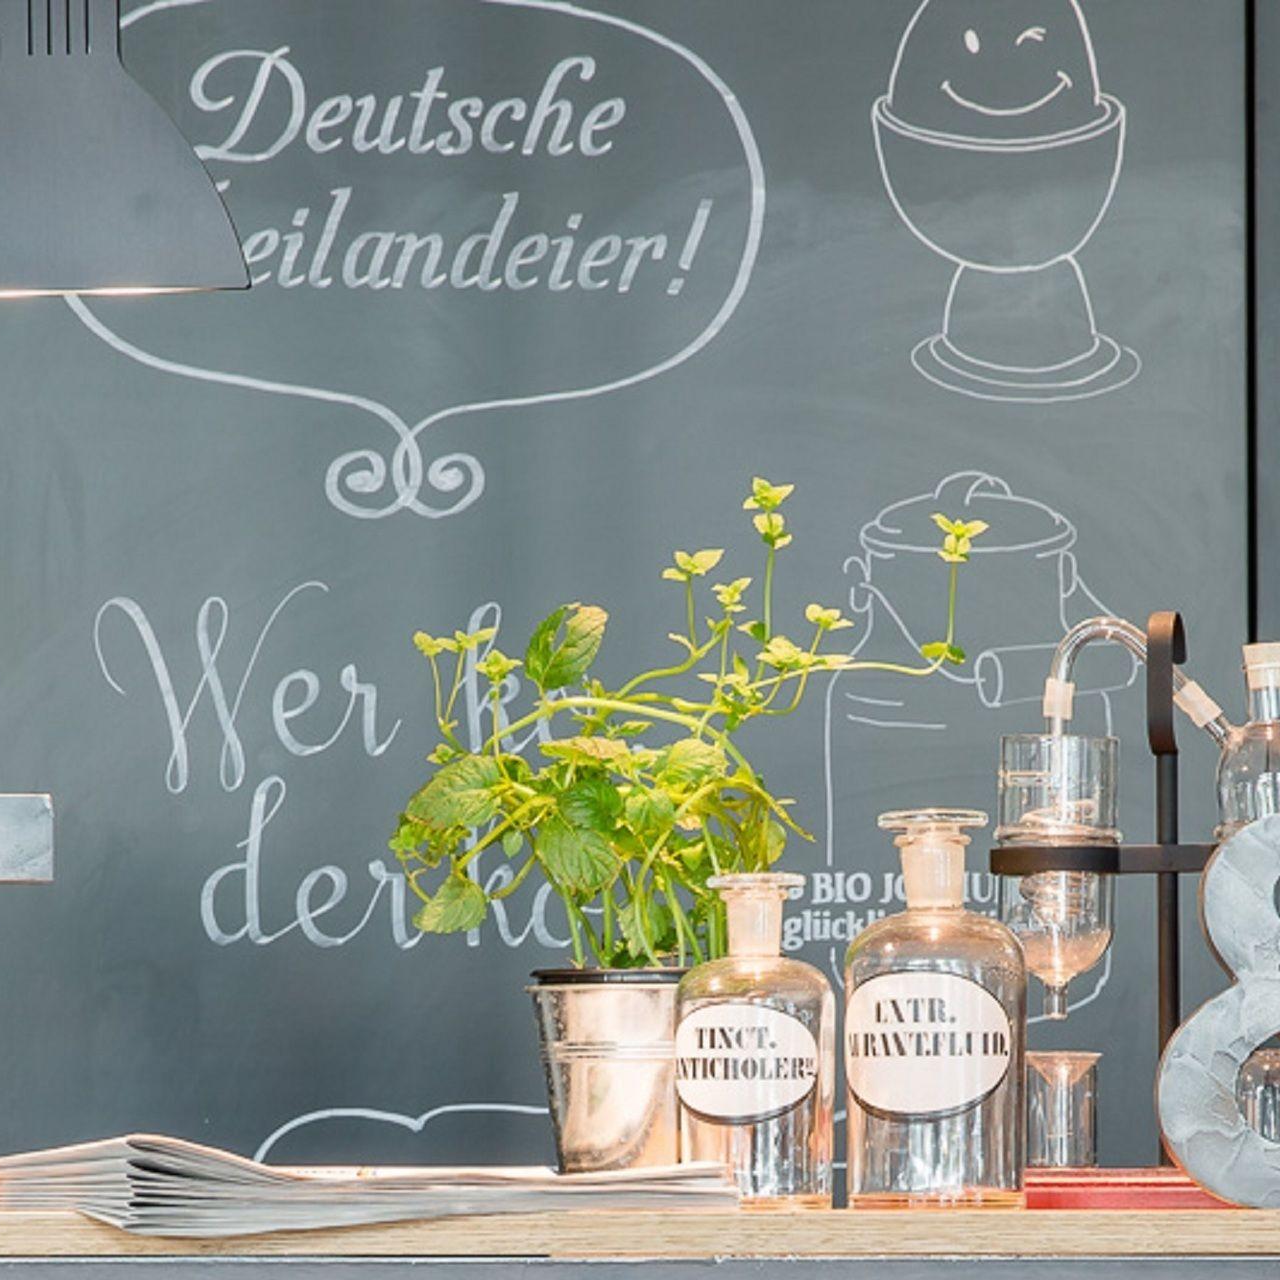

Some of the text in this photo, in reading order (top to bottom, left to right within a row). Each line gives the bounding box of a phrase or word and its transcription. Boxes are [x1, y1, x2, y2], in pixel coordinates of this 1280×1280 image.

[190, 46, 626, 162] Deutsche
[216, 180, 713, 295] eilandeier!
[94, 581, 402, 793] Wer
[200, 776, 426, 950] der
[811, 872, 872, 904] BIO
[696, 1026, 777, 1049] TINCT.
